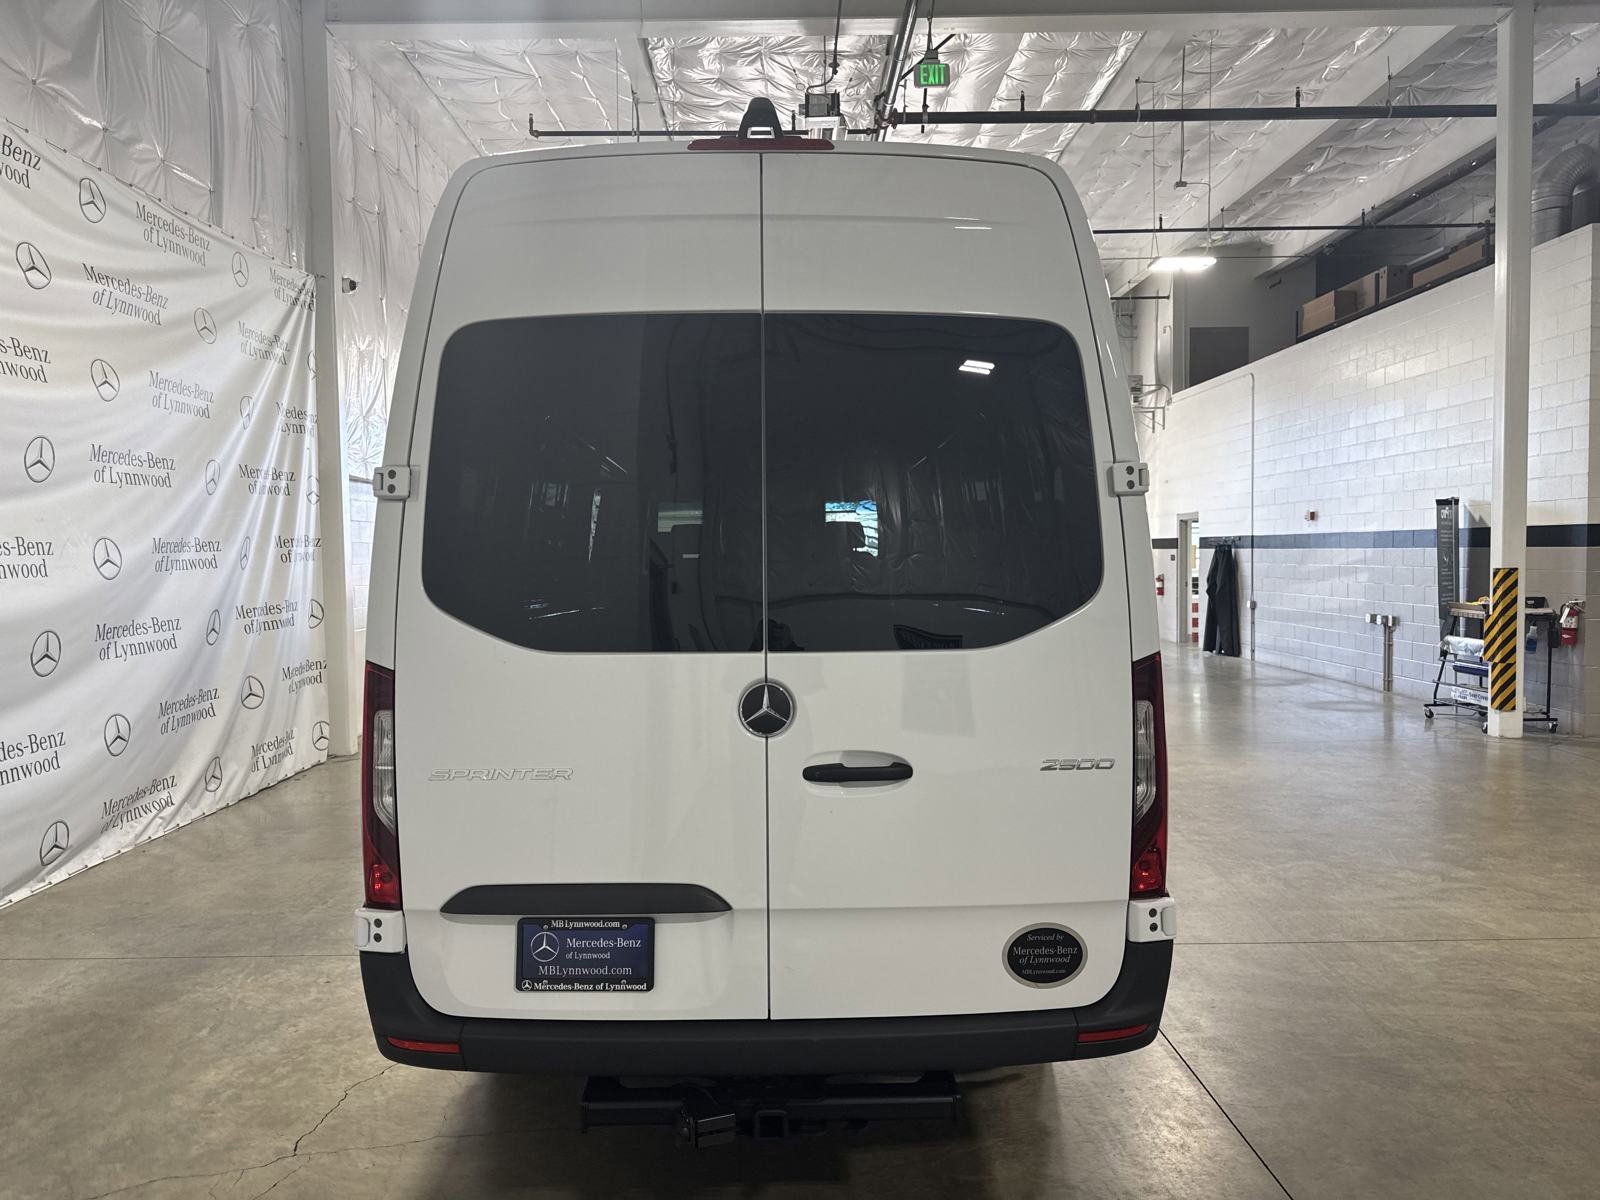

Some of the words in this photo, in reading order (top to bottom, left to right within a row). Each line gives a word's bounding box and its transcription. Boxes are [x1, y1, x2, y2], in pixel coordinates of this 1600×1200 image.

[920, 64, 945, 85] EXIT
[136, 201, 211, 252] Mercedes-Benz
[143, 226, 154, 243] of
[156, 229, 206, 267] Lynnwood
[82, 263, 169, 310] Mercedes-Benz
[92, 288, 107, 306] of
[105, 291, 162, 326] Lynnwood
[149, 370, 214, 404] Mercedes-Benz
[152, 392, 163, 409] of
[163, 394, 210, 420] Lynnwood
[88, 443, 176, 471] Mercedes-Benz
[94, 465, 106, 483] of
[108, 466, 172, 489] Lynnwood
[152, 536, 222, 554] Mercedes-Benz
[280, 549, 292, 564] of
[155, 556, 165, 573] of
[164, 554, 218, 576] Lynnwood
[95, 616, 181, 642] Mercedes-Benz
[244, 619, 255, 635] of
[99, 641, 112, 661] of
[113, 633, 178, 662] Lynnwood
[158, 688, 220, 719] Mercedes-Benz
[160, 716, 171, 735] of
[171, 702, 217, 733] Lynnwood
[428, 767, 574, 782] SPRINTER
[1040, 759, 1115, 771] 2500
[102, 776, 177, 819] Mercedes-Benz
[111, 791, 175, 830] Lynnwood
[551, 919, 620, 930] MBLynnwood.com
[566, 937, 642, 949] Mercedes-Benz
[1012, 945, 1078, 956] Mercedes-Benz
[565, 951, 573, 960] of
[574, 951, 611, 961] Lynnwood
[538, 965, 633, 977] MBLynnwood.com
[533, 982, 593, 991] Mercedes-Benz
[595, 983, 604, 991] of
[605, 982, 647, 992] Lynnwood
